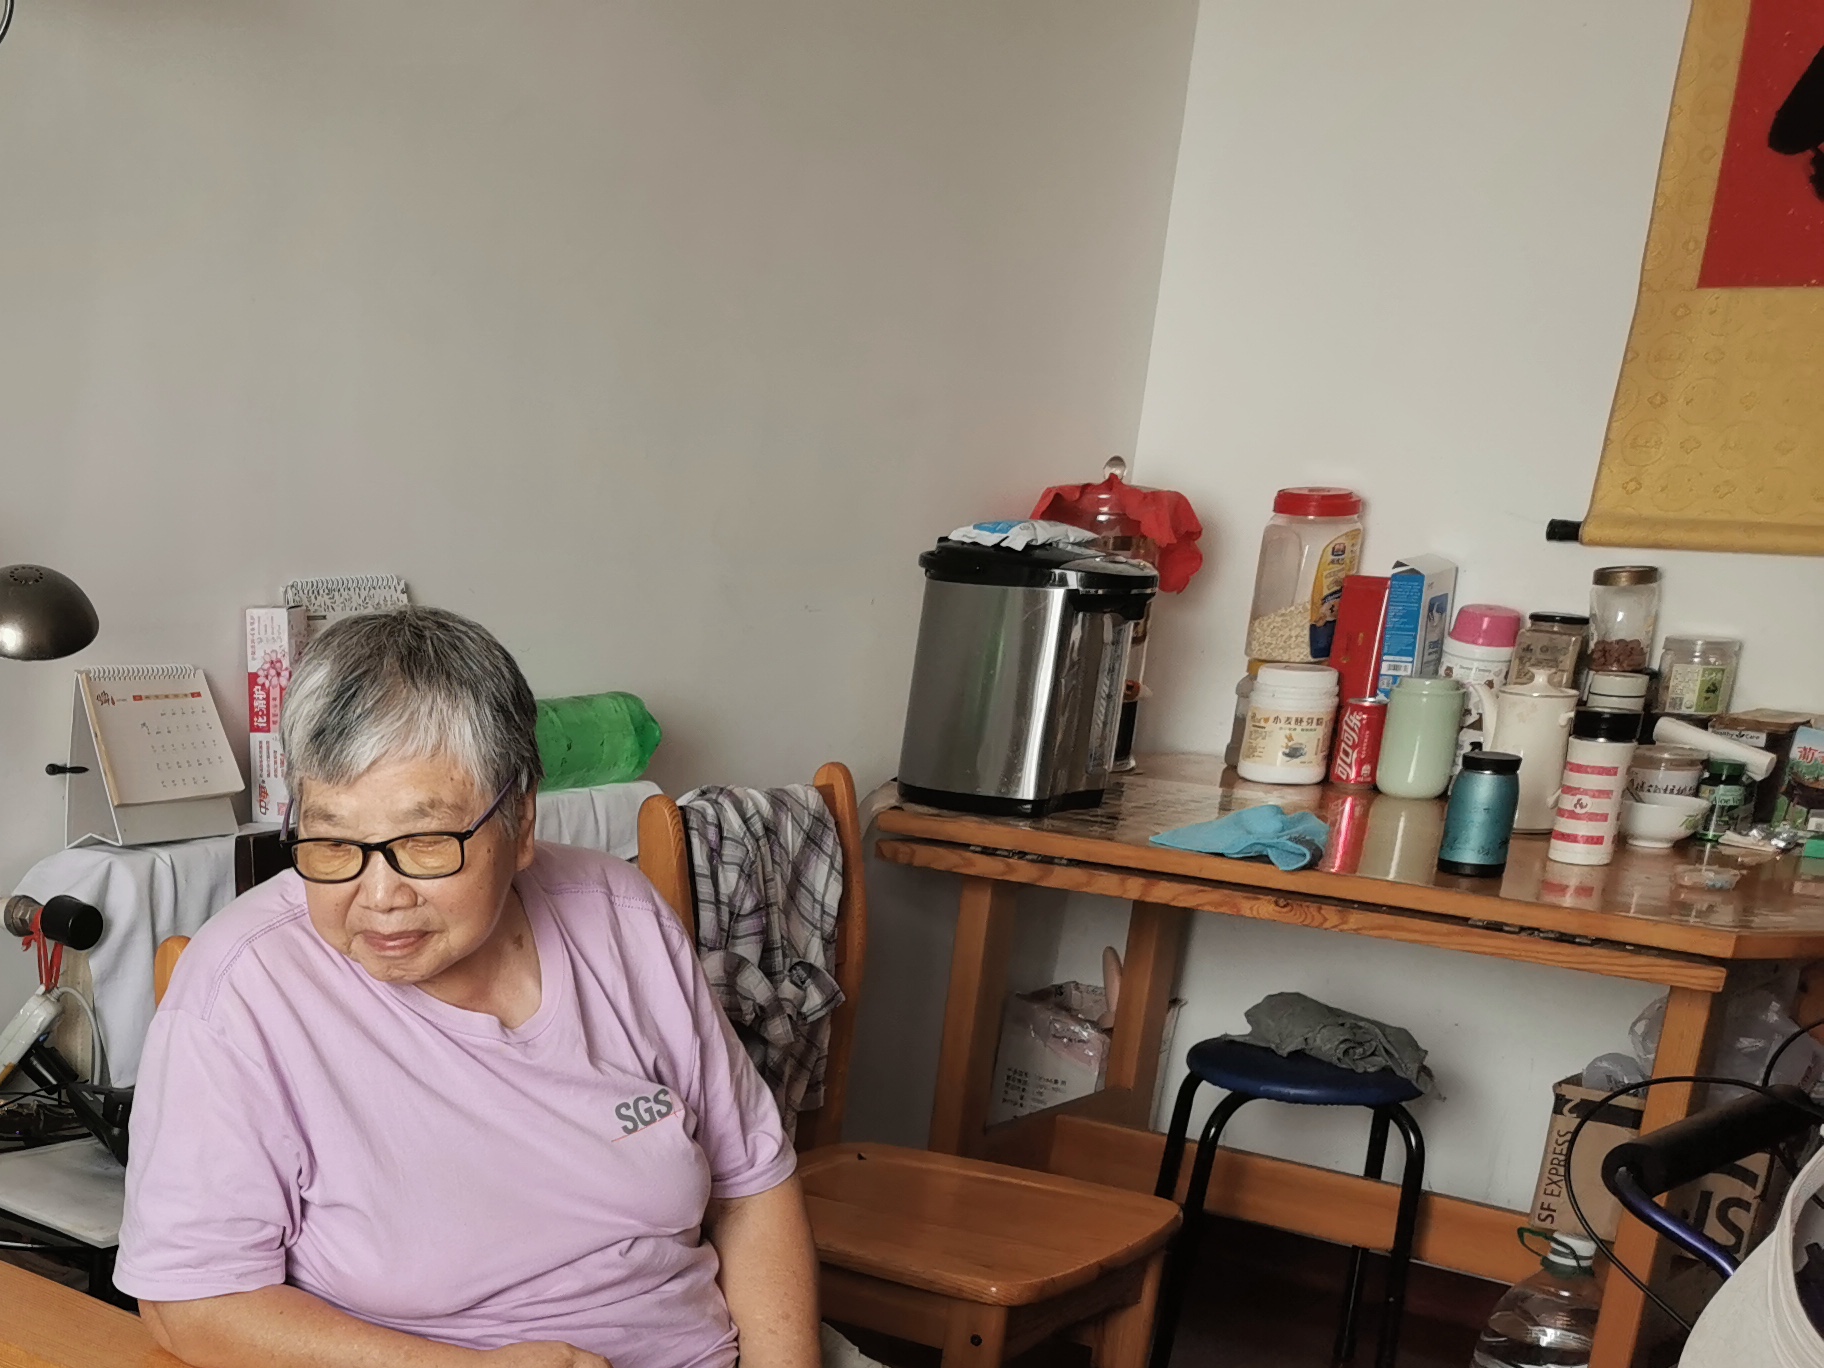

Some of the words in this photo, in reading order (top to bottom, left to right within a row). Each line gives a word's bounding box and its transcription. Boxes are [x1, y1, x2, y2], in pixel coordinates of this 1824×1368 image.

[1335, 707, 1364, 780] 可口可乐
[615, 1088, 673, 1135] SGS
[1543, 1129, 1574, 1198] EXPRESS
[1538, 1203, 1557, 1225] SF
